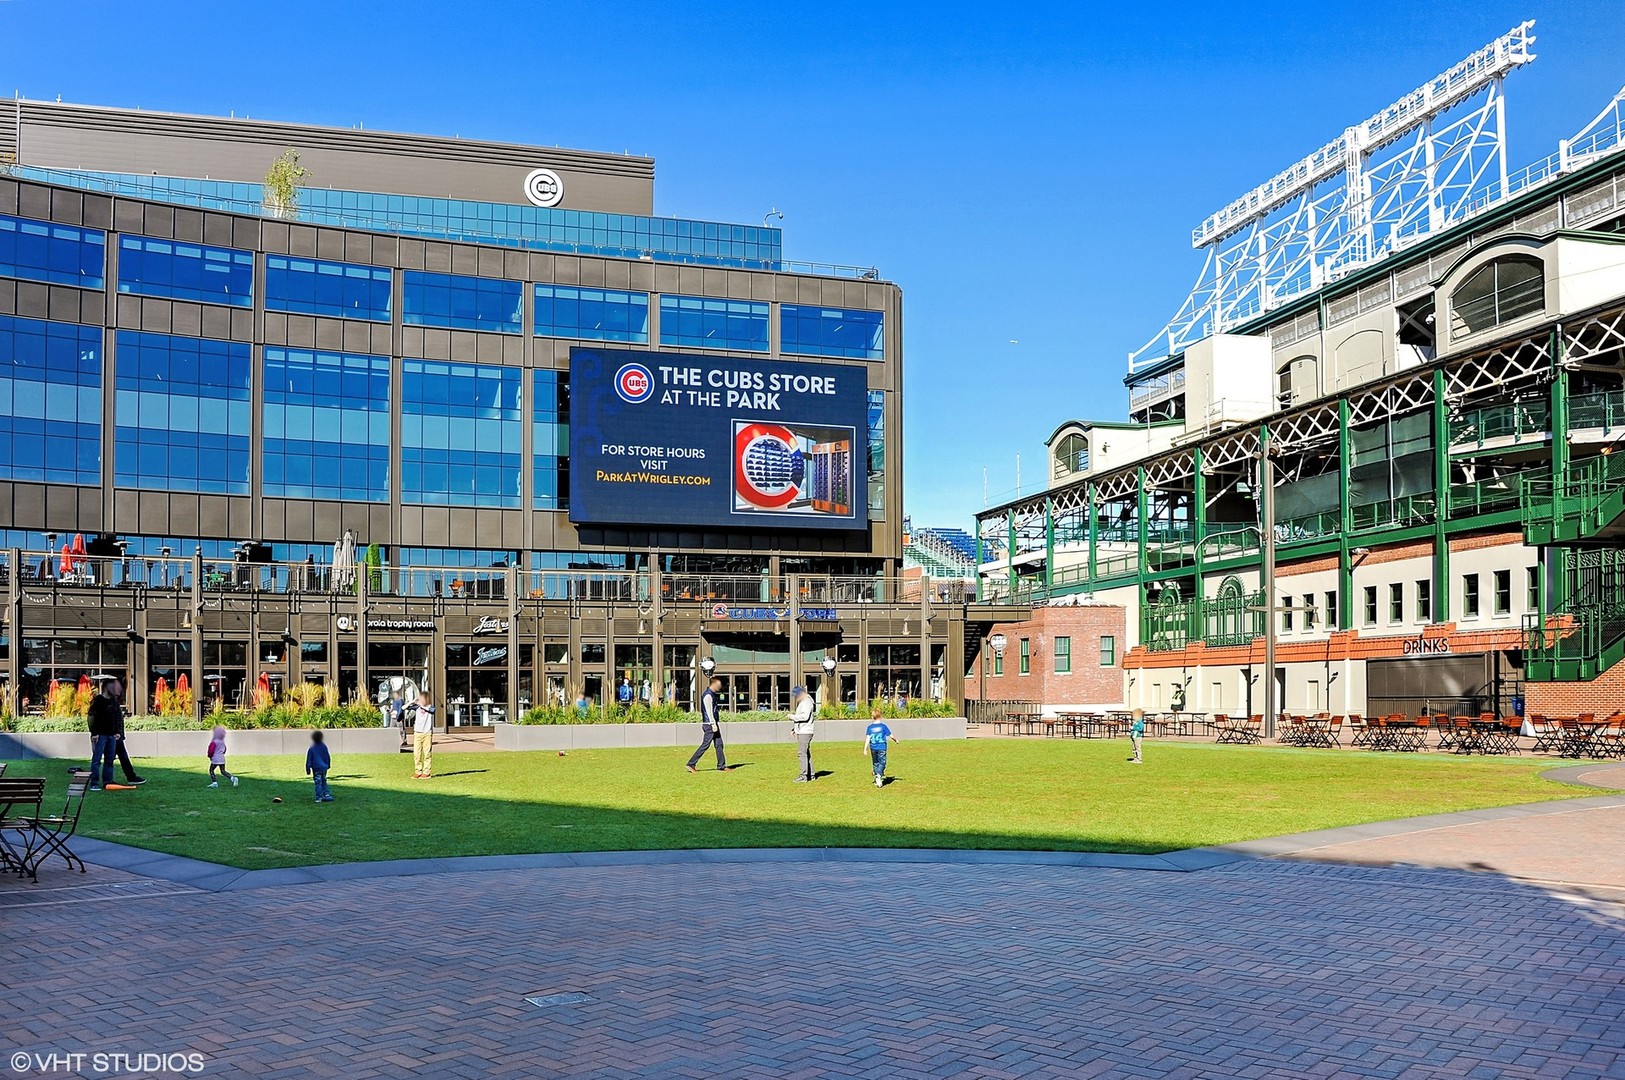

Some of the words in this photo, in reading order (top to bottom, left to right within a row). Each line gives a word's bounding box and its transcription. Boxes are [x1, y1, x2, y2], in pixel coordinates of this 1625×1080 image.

[620, 370, 647, 395] CUBS
[658, 366, 702, 386] THE
[707, 369, 765, 390] CUBS
[768, 373, 836, 395] STORE
[660, 389, 683, 405] AT
[686, 390, 721, 407] THE
[726, 390, 781, 411] PARK
[601, 444, 626, 456] FOR
[627, 445, 664, 457] STORE
[666, 447, 706, 459] HOURS
[640, 459, 668, 471] VISIT
[729, 608, 779, 620] CUBS
[353, 619, 386, 627] morola
[386, 619, 412, 629] trophy
[472, 615, 509, 634] Jostns
[1402, 638, 1450, 655] DRINKS
